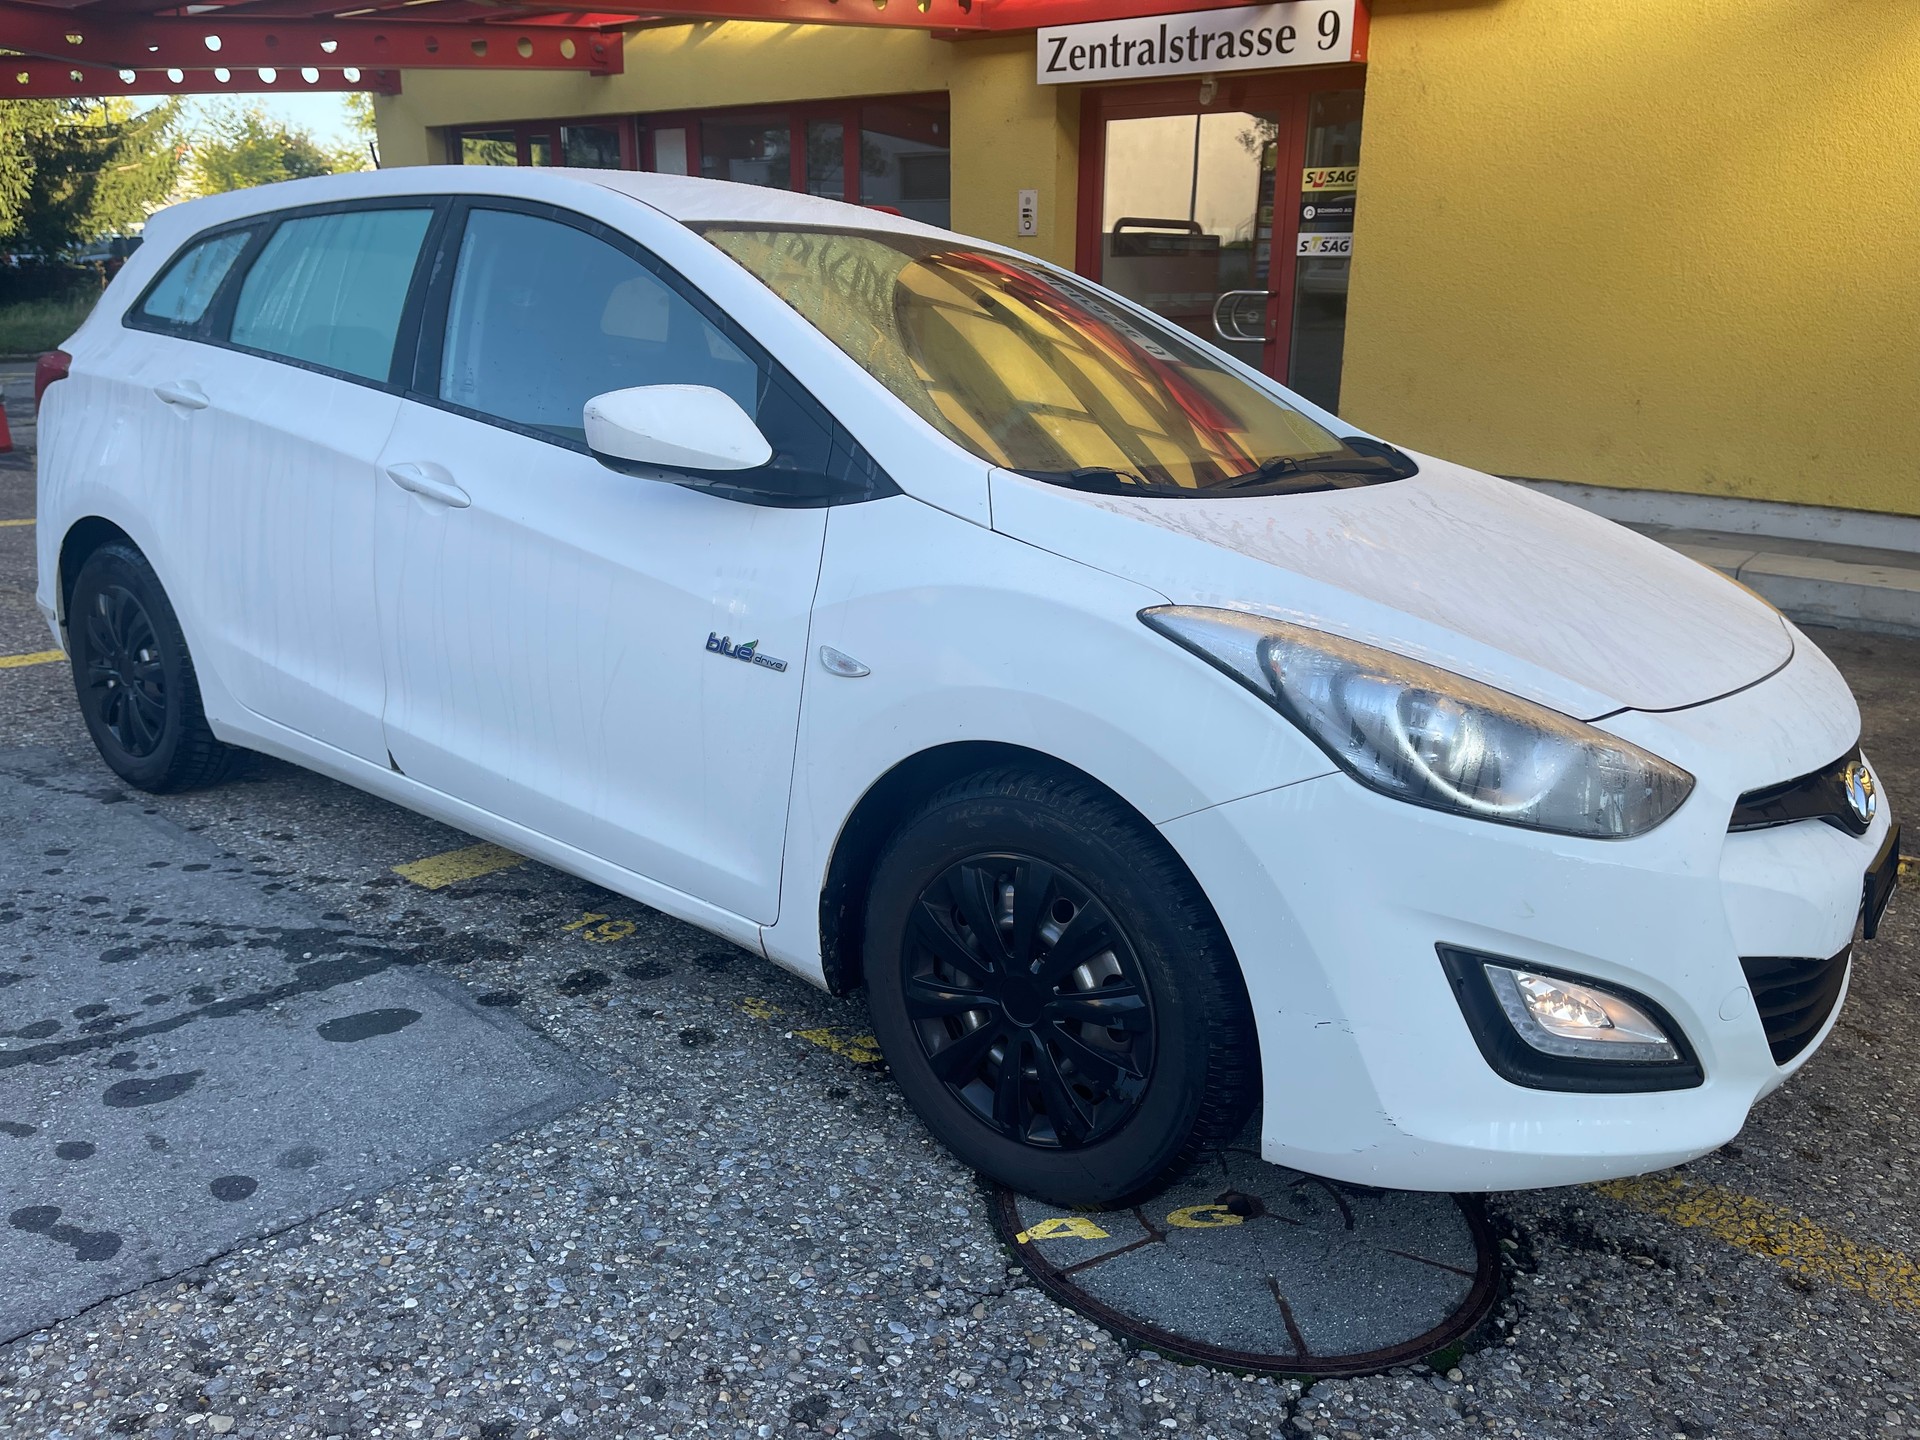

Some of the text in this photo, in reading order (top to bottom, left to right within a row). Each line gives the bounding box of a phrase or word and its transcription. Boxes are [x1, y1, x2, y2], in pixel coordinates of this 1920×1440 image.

[1046, 9, 1341, 73] Zentralstrasse 9
[1305, 170, 1356, 187] SUSAG
[706, 631, 784, 670] blue drive
